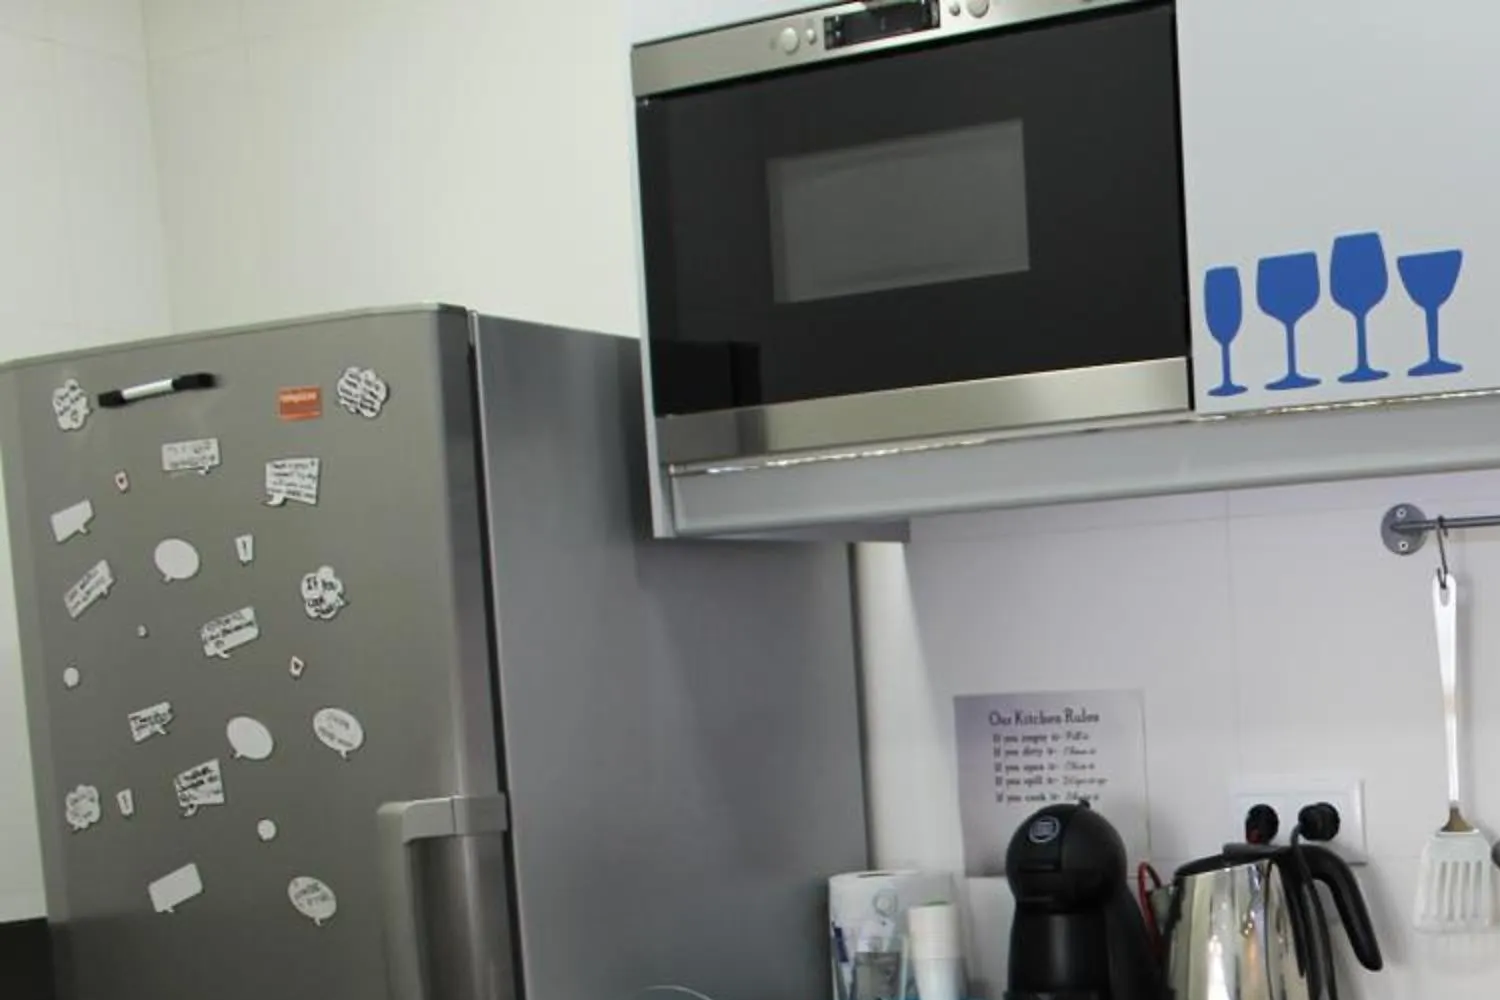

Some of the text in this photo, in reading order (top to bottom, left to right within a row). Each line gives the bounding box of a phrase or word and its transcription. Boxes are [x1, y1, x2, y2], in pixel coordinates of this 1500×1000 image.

[988, 706, 1099, 726] Our Kitchen Rules
